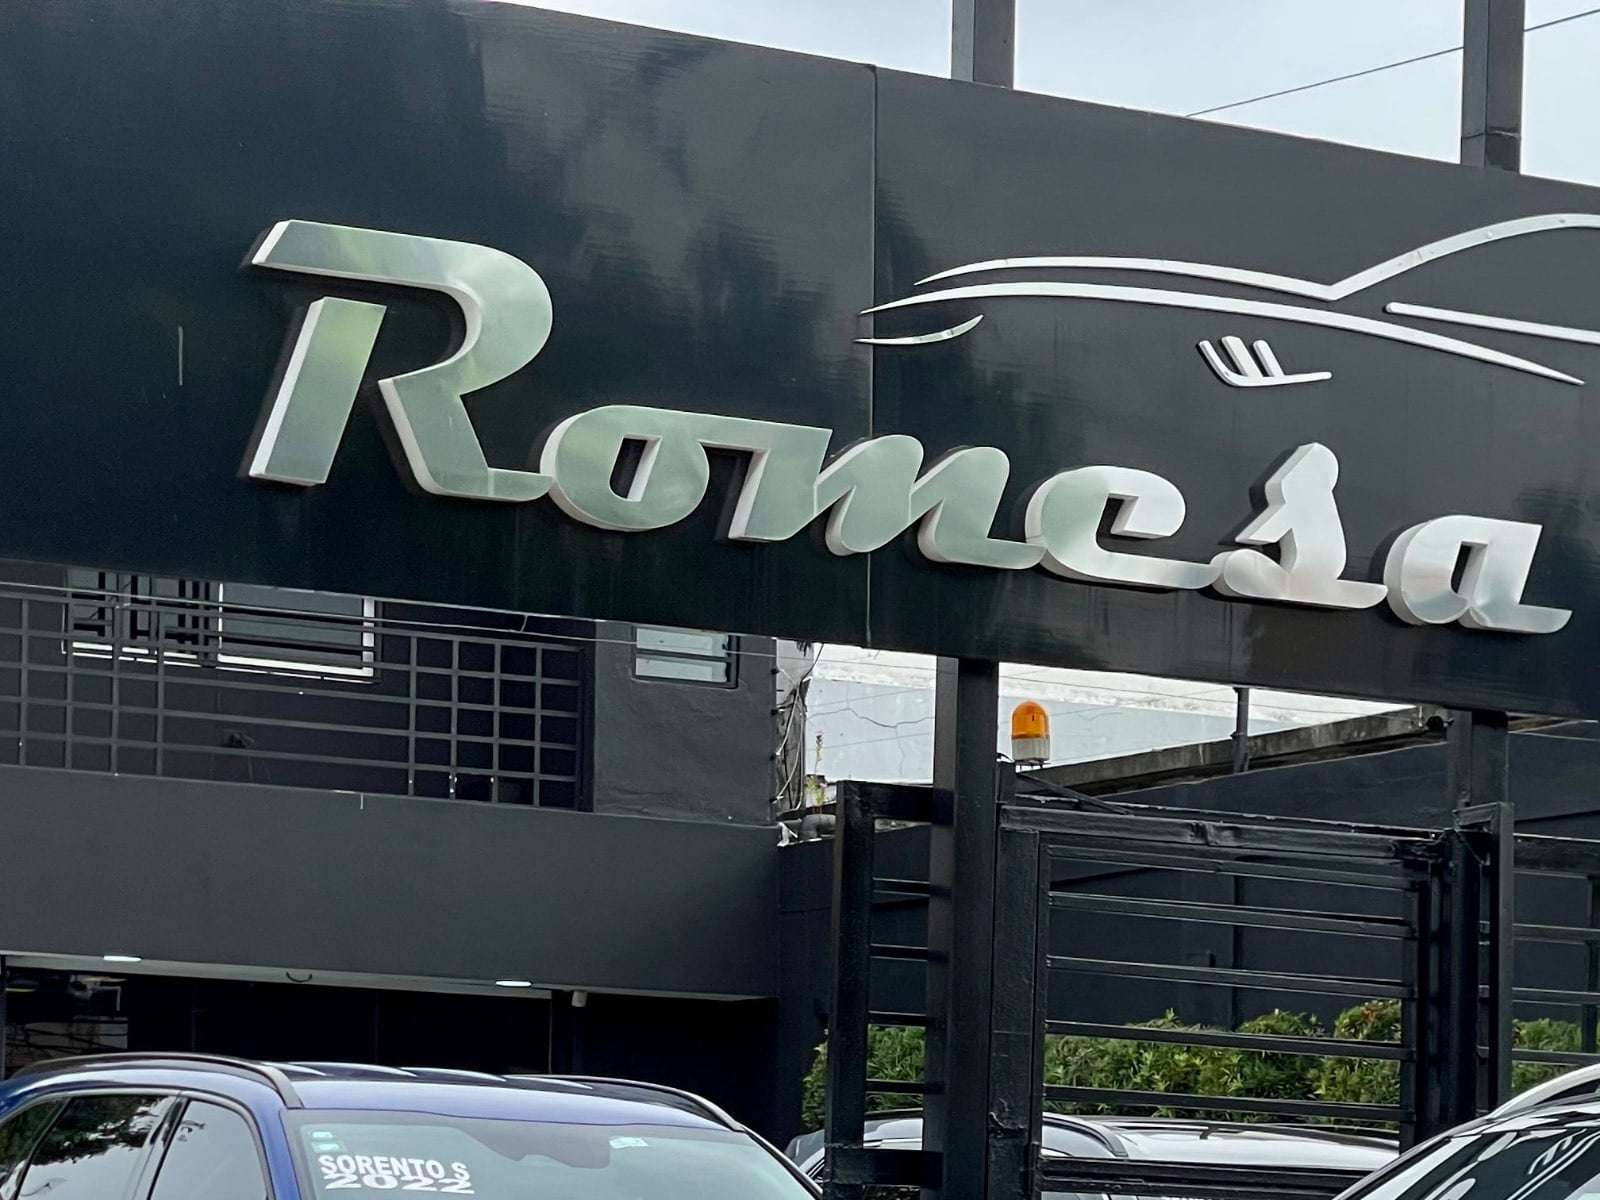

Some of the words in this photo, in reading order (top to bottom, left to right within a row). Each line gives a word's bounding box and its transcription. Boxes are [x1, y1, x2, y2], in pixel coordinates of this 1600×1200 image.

[247, 218, 1573, 635] Romesa
[318, 1154, 446, 1180] SORENTO
[450, 1161, 471, 1182] S
[322, 1171, 476, 1195] 2022
